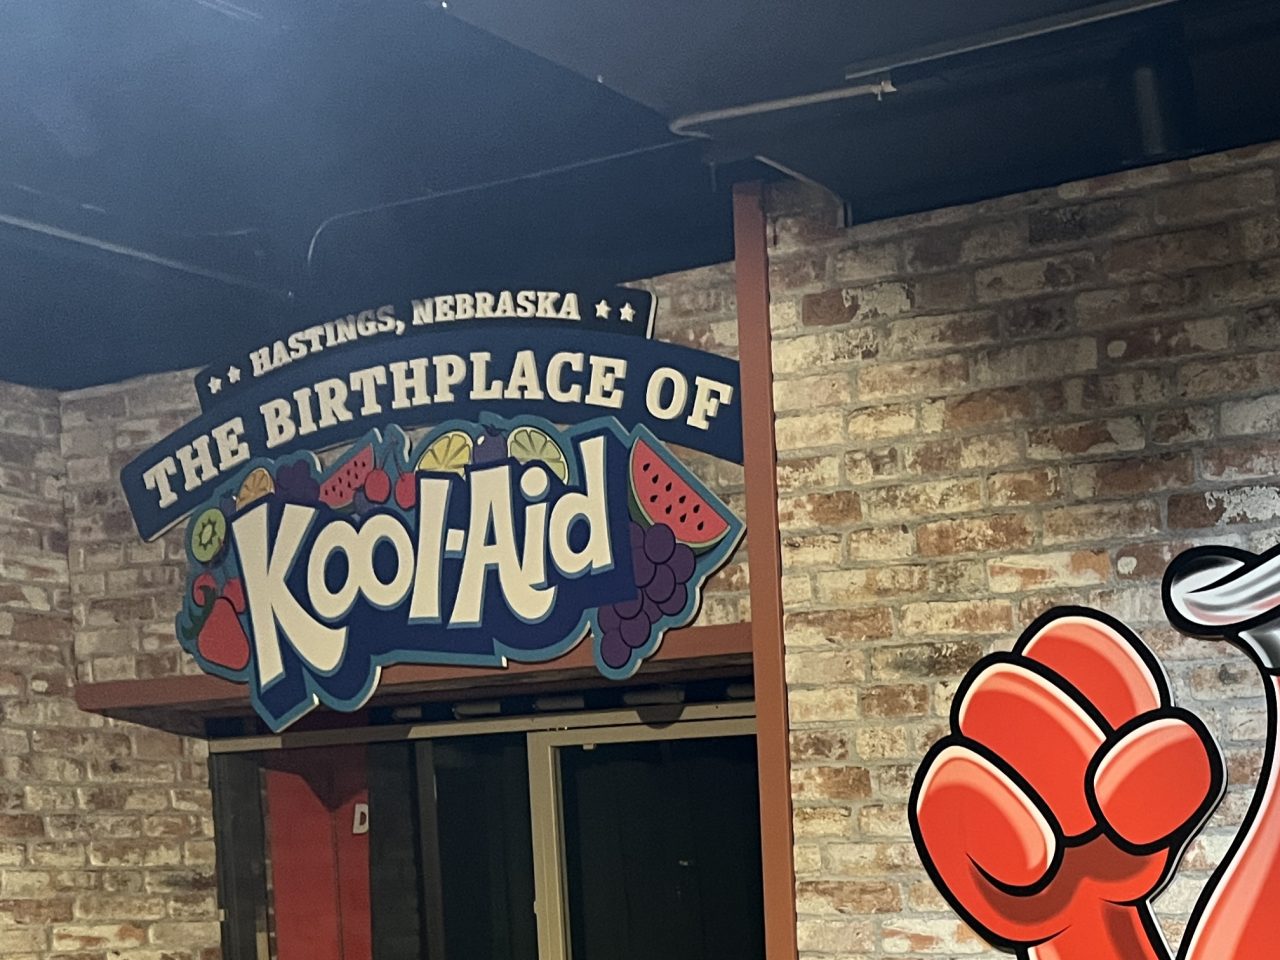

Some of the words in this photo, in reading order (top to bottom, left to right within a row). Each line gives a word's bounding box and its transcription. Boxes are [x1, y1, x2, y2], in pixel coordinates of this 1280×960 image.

[249, 305, 406, 377] HASTINGS,
[412, 290, 581, 326] NEBRASKA
[142, 416, 253, 509] THE
[259, 349, 628, 449] BIRTHPLACE
[645, 367, 734, 431] OF
[231, 435, 613, 688] Kool-Aid
